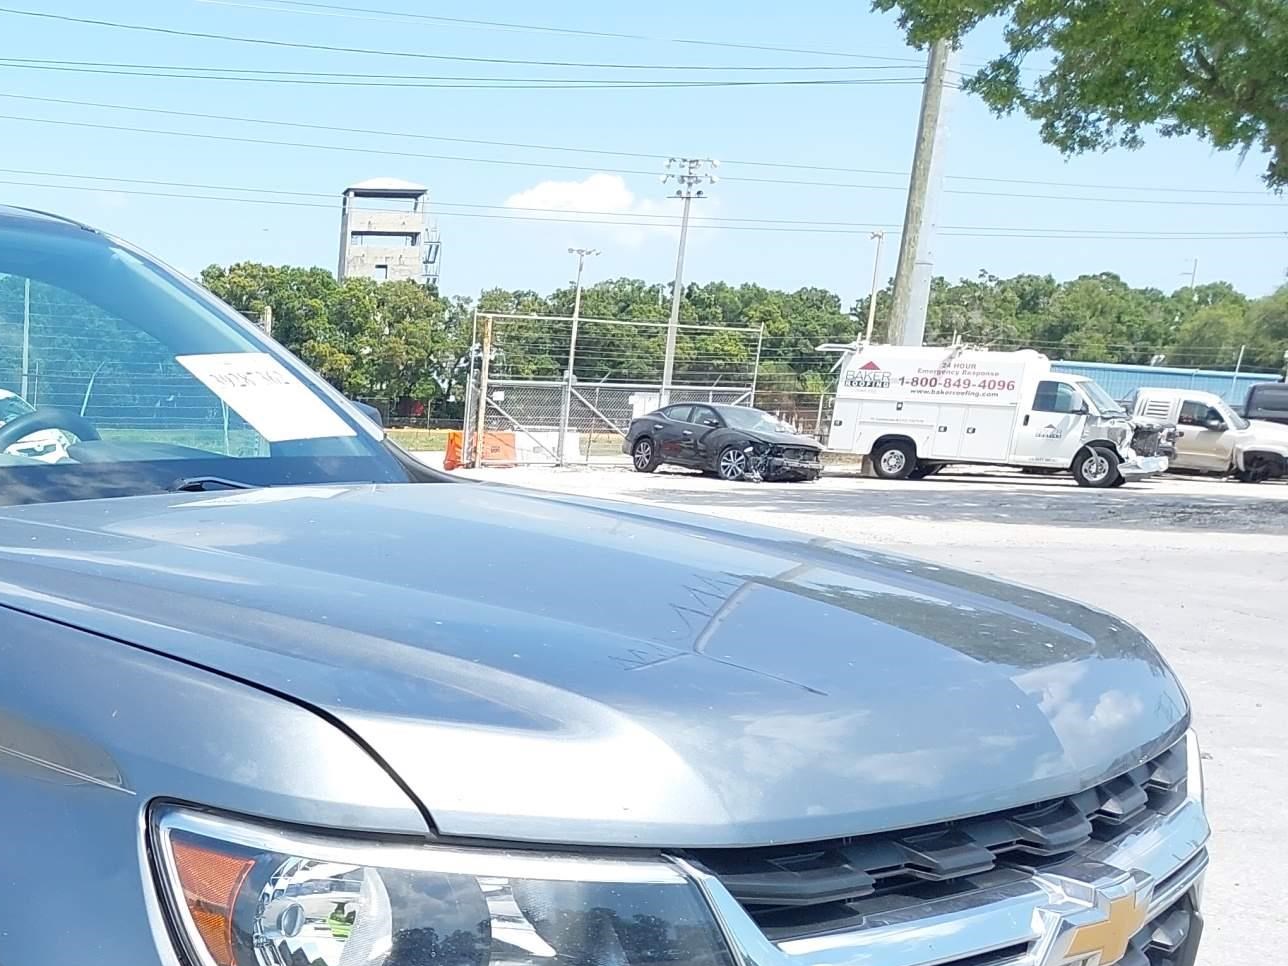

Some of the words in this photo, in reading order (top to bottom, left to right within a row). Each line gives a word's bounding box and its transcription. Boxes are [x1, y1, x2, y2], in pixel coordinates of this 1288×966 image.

[845, 370, 892, 381] BAKER
[917, 367, 960, 376] Emergency
[961, 369, 1000, 377] Response
[844, 380, 890, 388] ROOFING
[898, 375, 1016, 391] 1-800-849-4096
